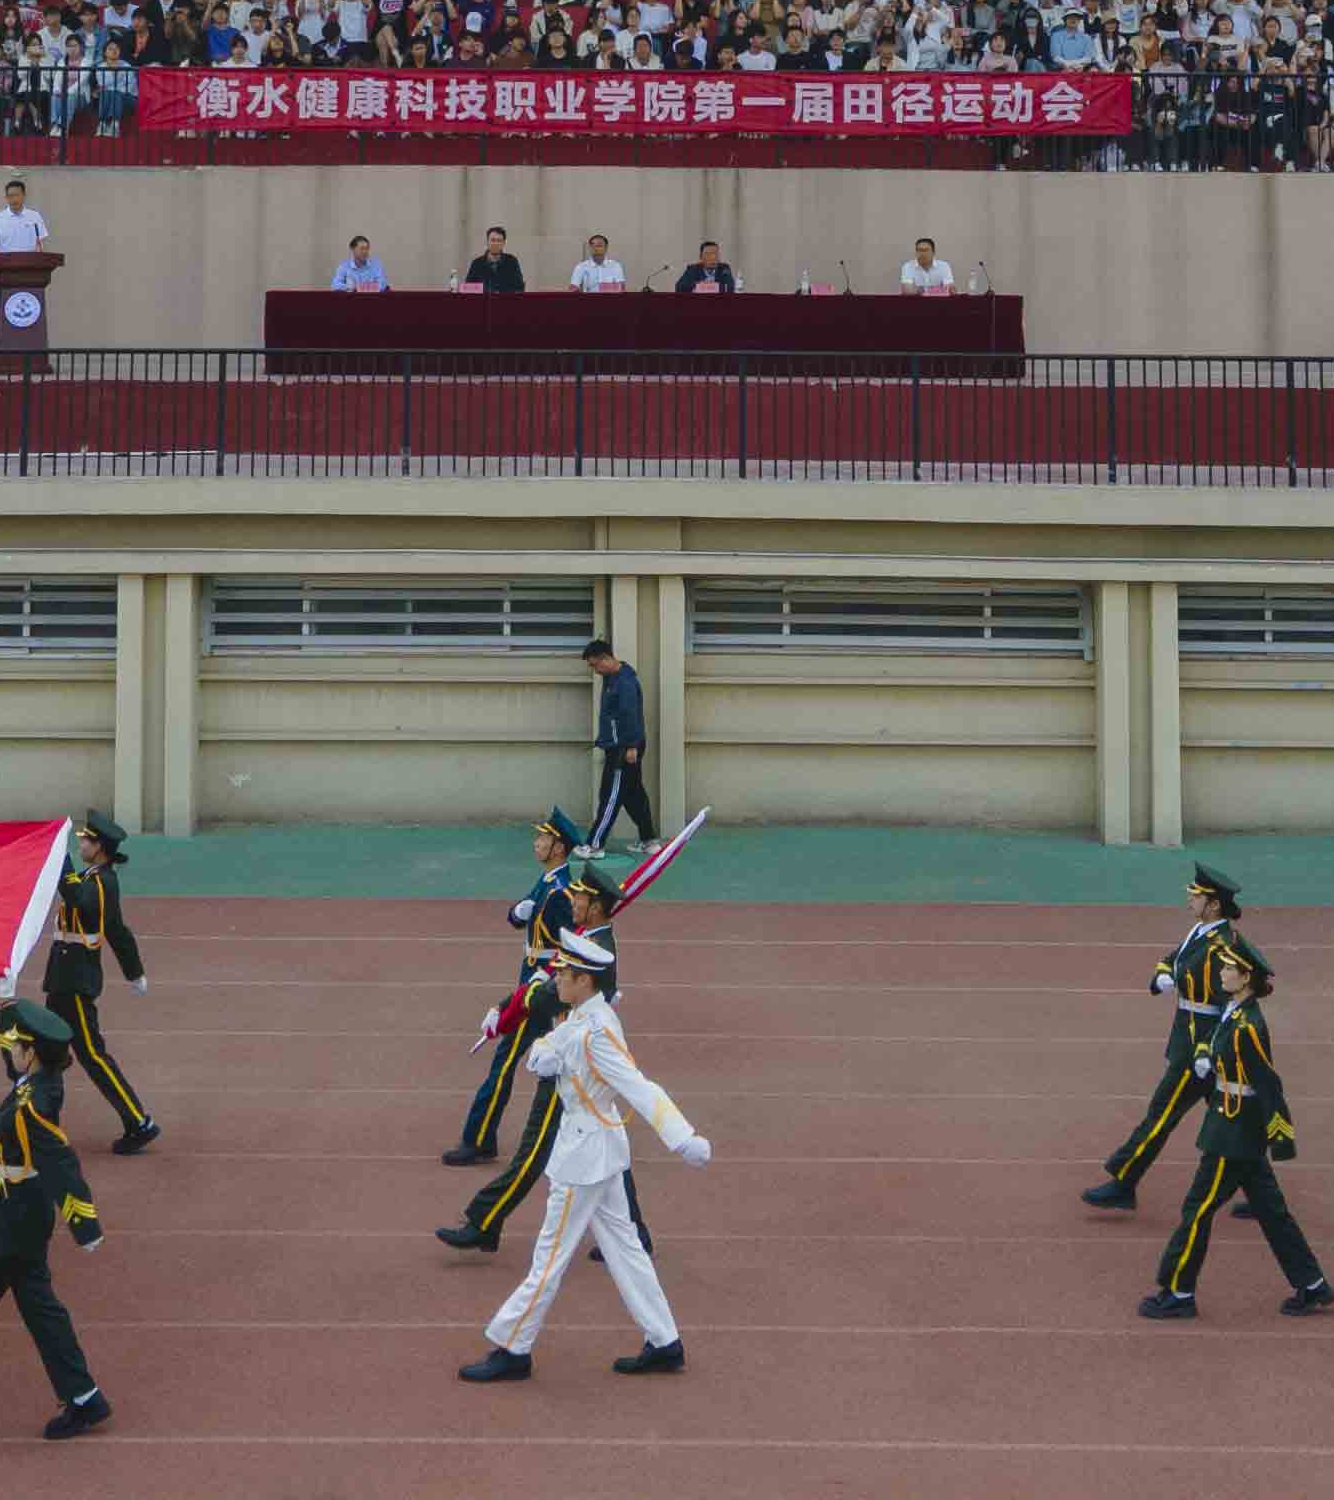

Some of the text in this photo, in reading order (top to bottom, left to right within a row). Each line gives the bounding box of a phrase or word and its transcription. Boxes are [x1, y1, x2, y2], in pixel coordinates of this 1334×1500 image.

[196, 77, 1083, 123] 衡水健康科技职业学院第一届田径运动会
